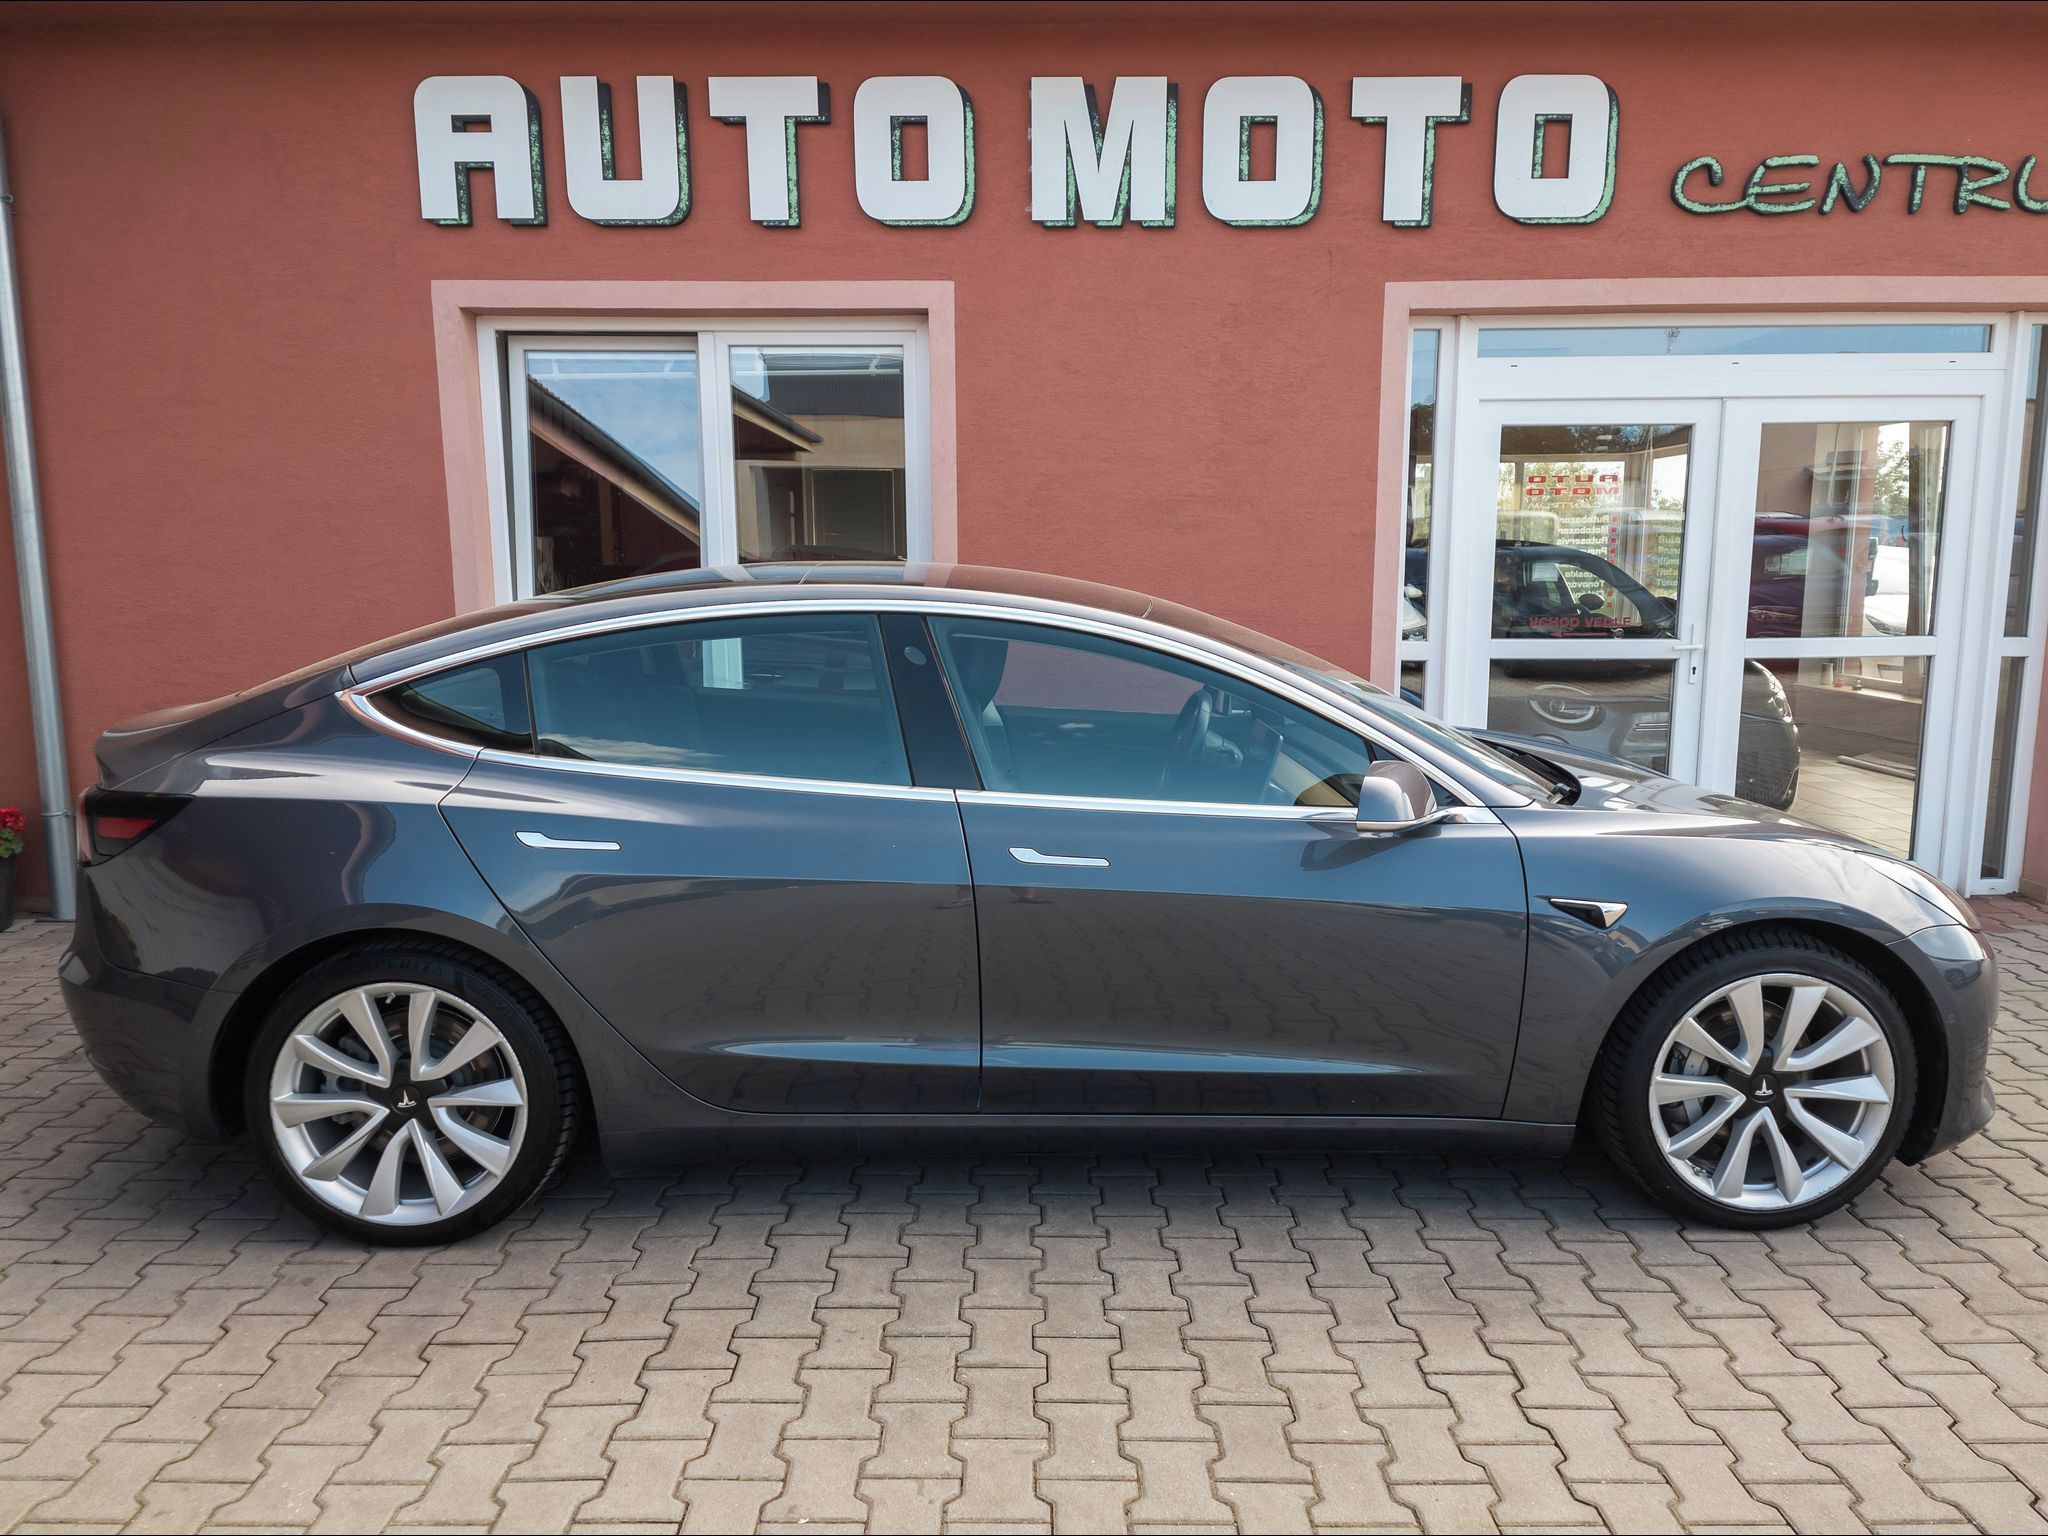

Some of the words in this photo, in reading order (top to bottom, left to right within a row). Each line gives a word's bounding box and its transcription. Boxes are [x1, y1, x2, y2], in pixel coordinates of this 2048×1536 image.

[413, 75, 975, 227] AUTO
[1030, 73, 1620, 228] MOTO
[1528, 616, 1580, 628] VCHOD
